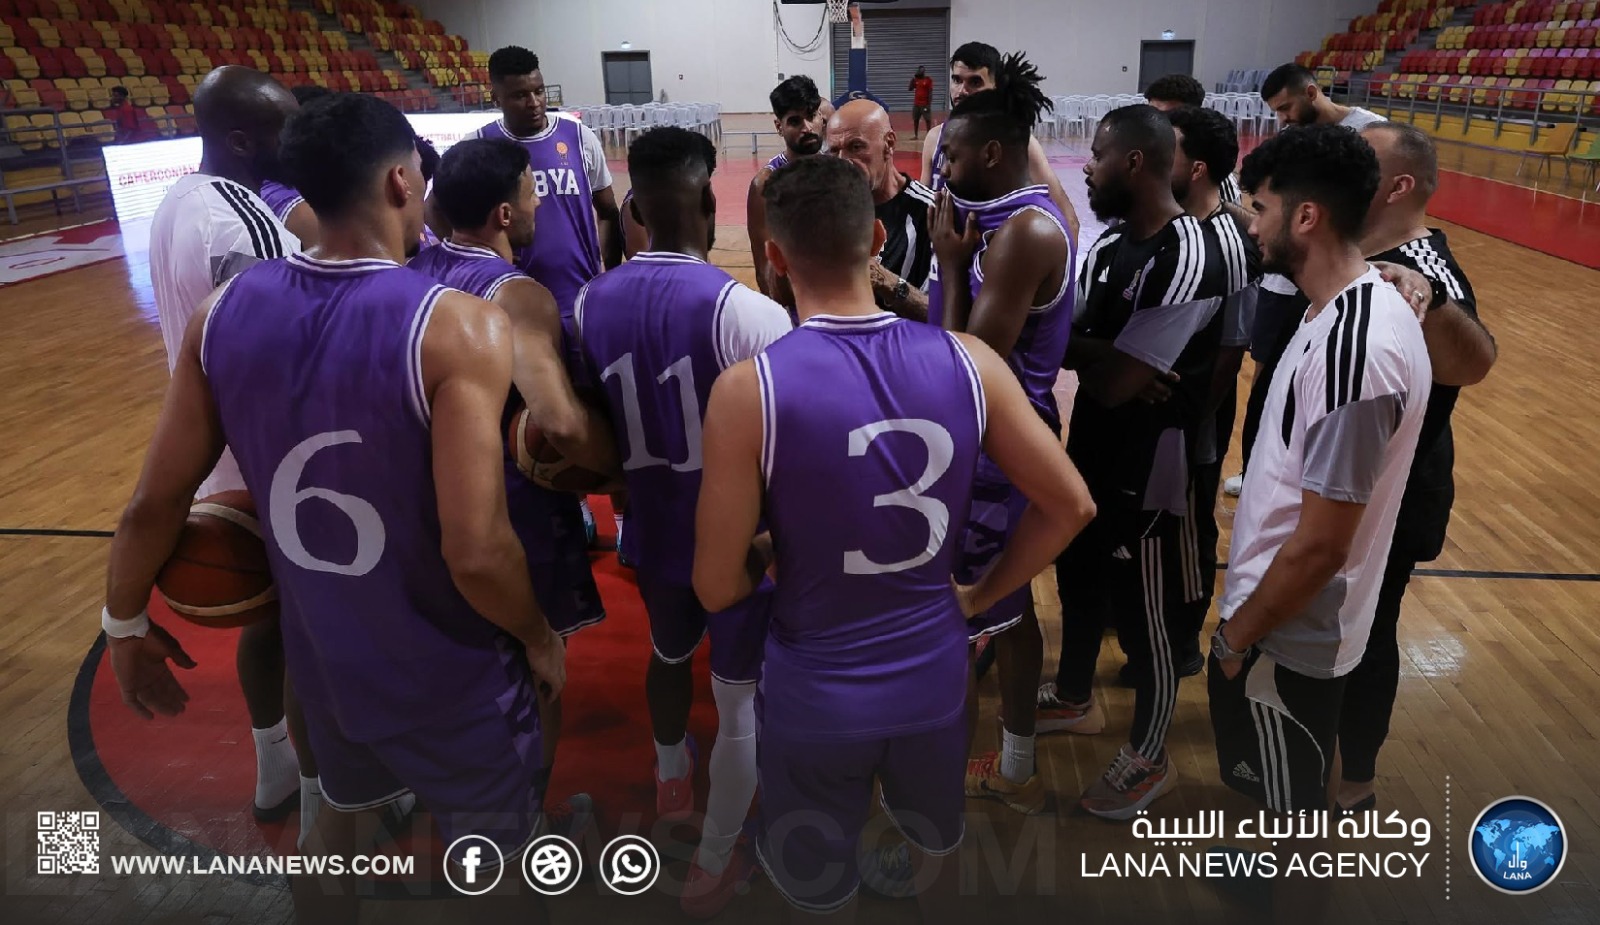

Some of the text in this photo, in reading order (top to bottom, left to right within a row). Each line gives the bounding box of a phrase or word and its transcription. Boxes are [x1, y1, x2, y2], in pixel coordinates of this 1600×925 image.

[600, 352, 703, 473] 11
[269, 429, 386, 577] 6
[843, 418, 955, 575] 3
